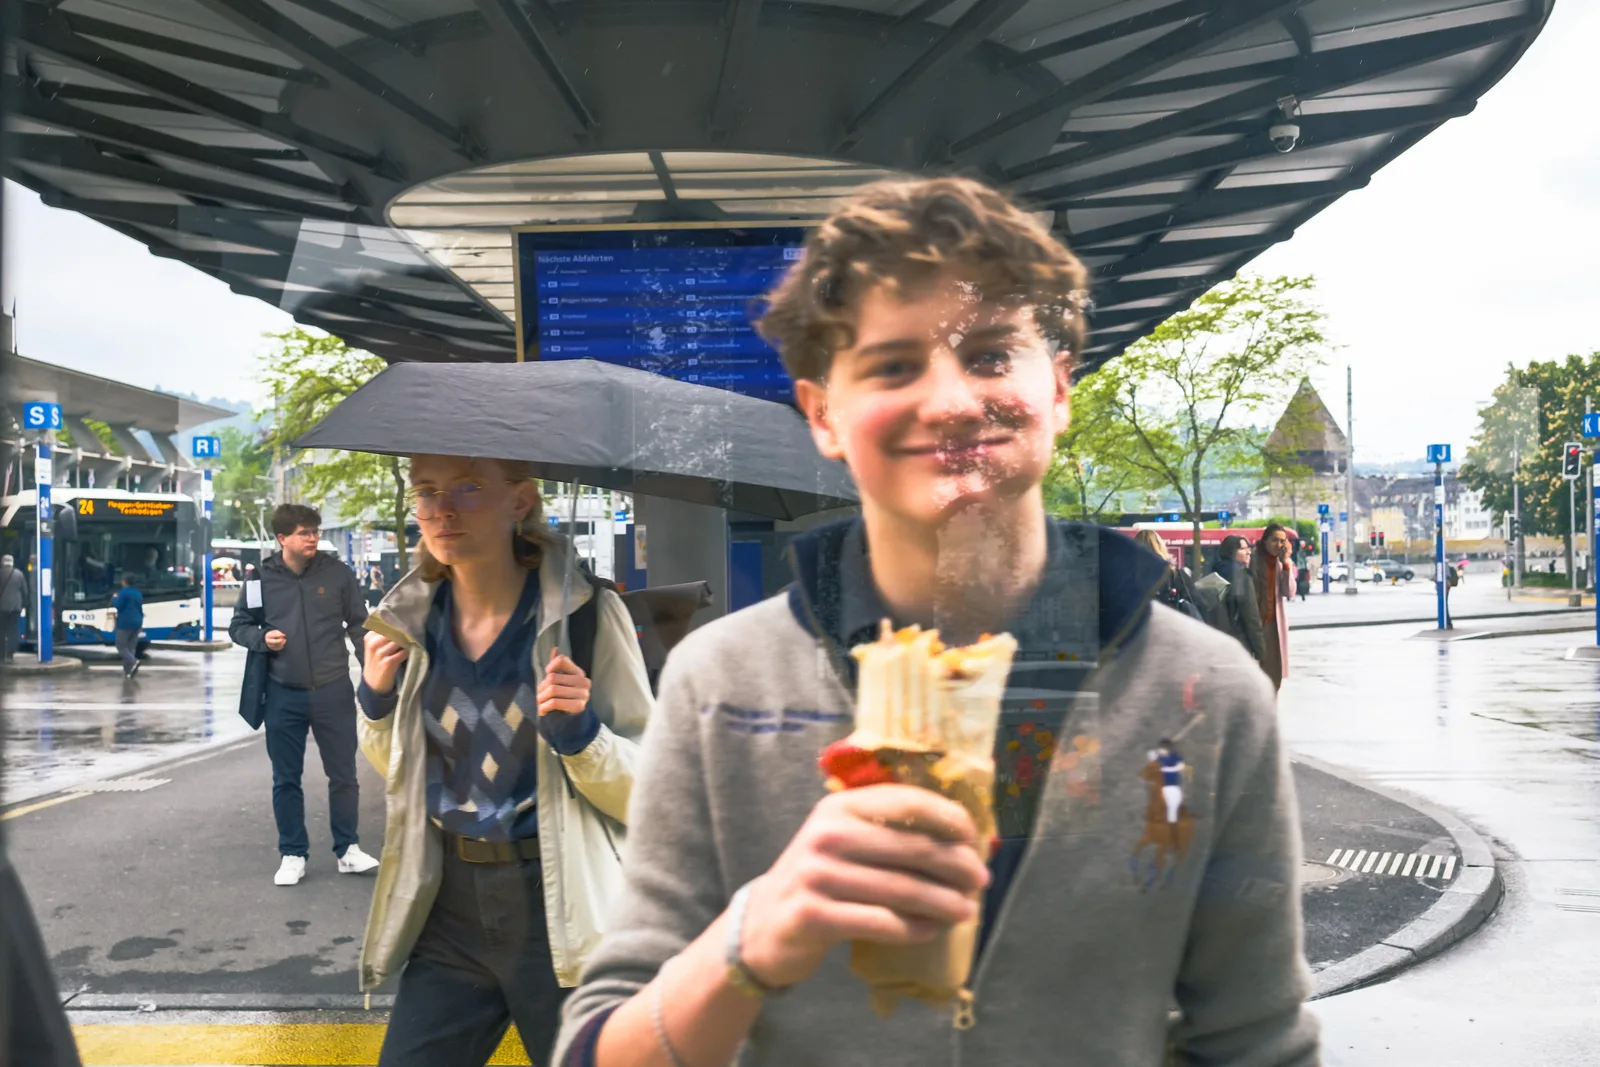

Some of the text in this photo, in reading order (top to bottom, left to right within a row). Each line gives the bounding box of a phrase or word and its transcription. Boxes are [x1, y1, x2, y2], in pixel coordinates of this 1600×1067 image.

[538, 254, 613, 263] Nächste Abfahrten
[30, 406, 45, 425] S
[51, 406, 59, 426] S
[1585, 417, 1592, 433] K
[197, 439, 208, 454] R
[1437, 445, 1446, 460] J
[79, 499, 94, 515] 24
